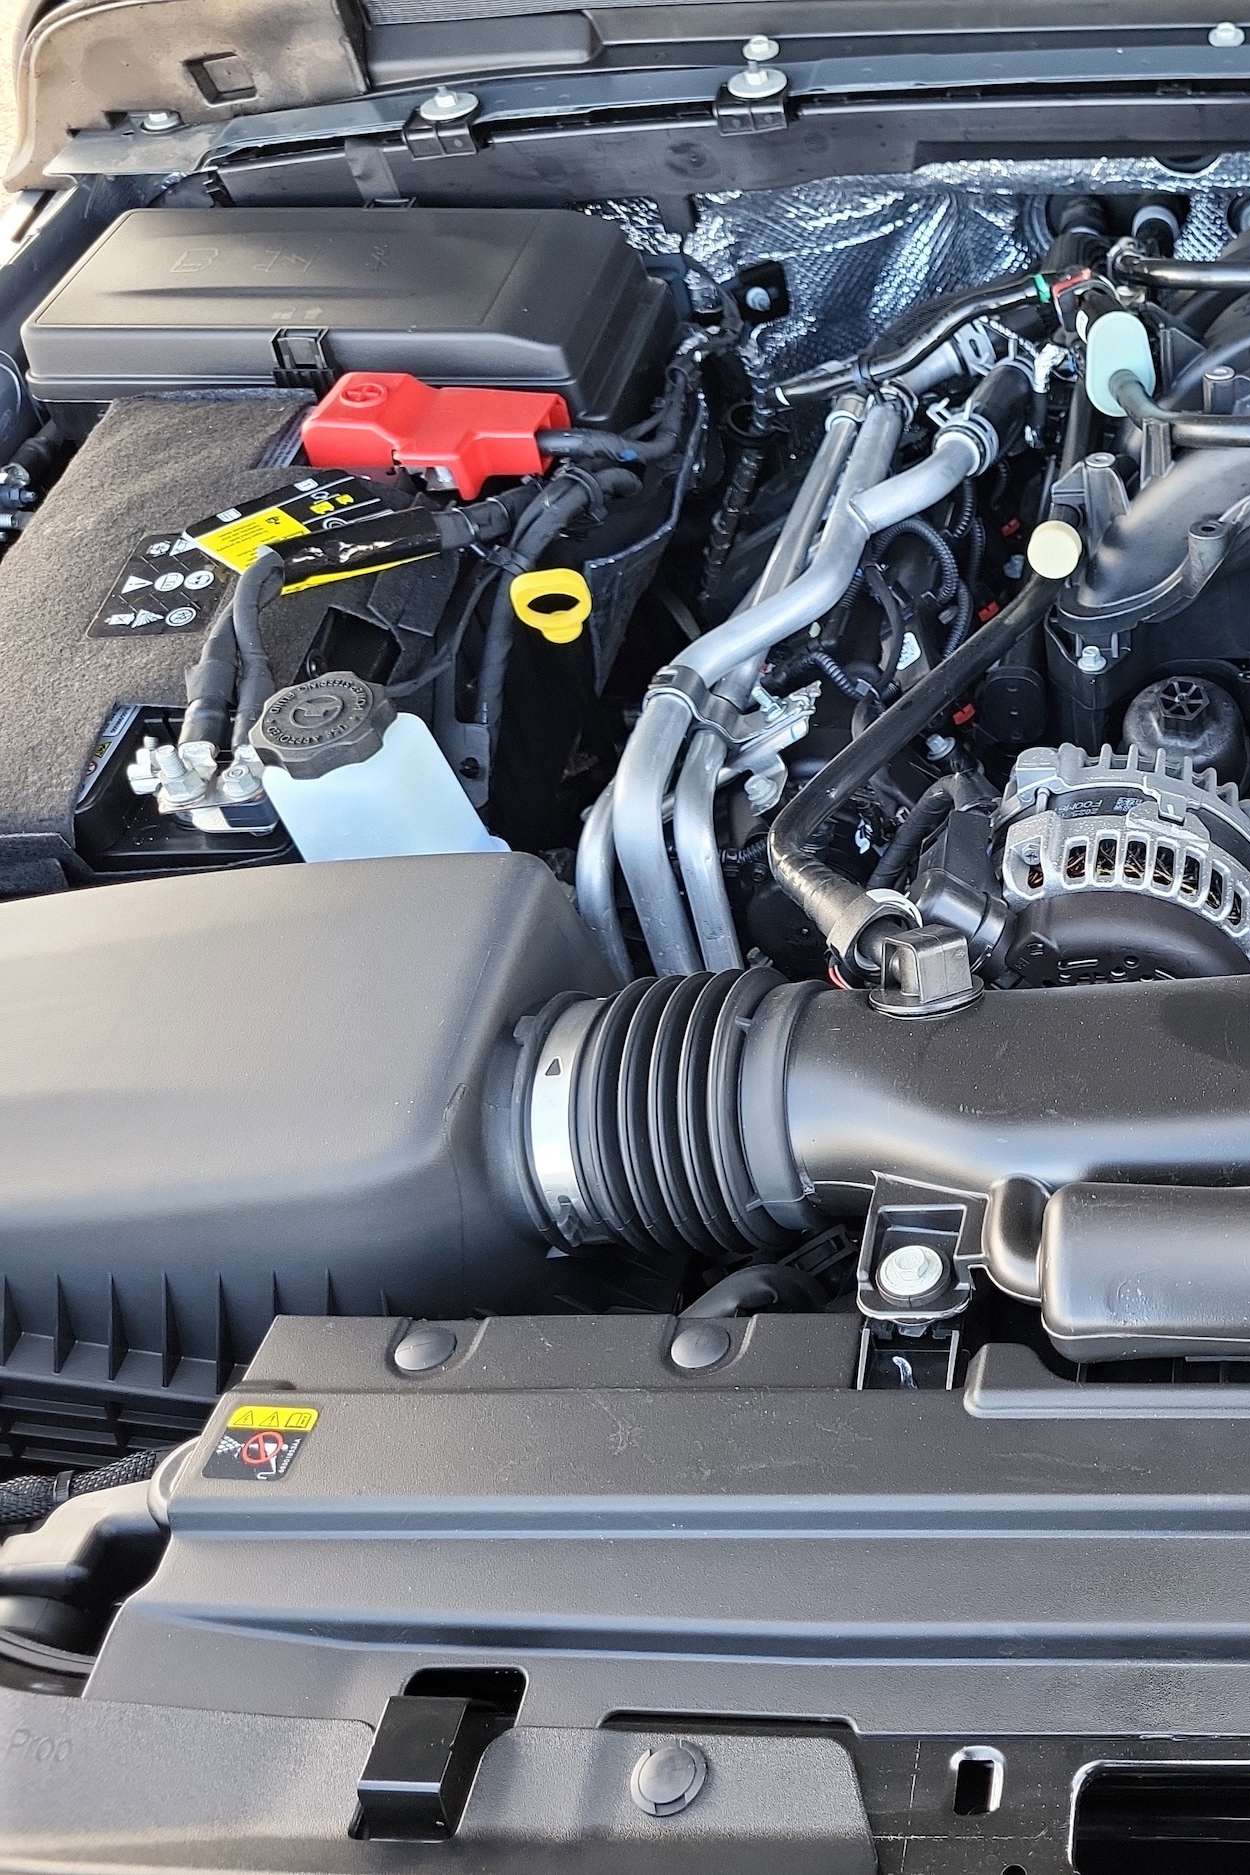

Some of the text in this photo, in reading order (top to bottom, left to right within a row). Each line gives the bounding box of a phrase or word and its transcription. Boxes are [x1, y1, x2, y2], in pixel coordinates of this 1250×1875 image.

[269, 691, 296, 715] FLUID
[266, 723, 348, 745] USE APPROVED
